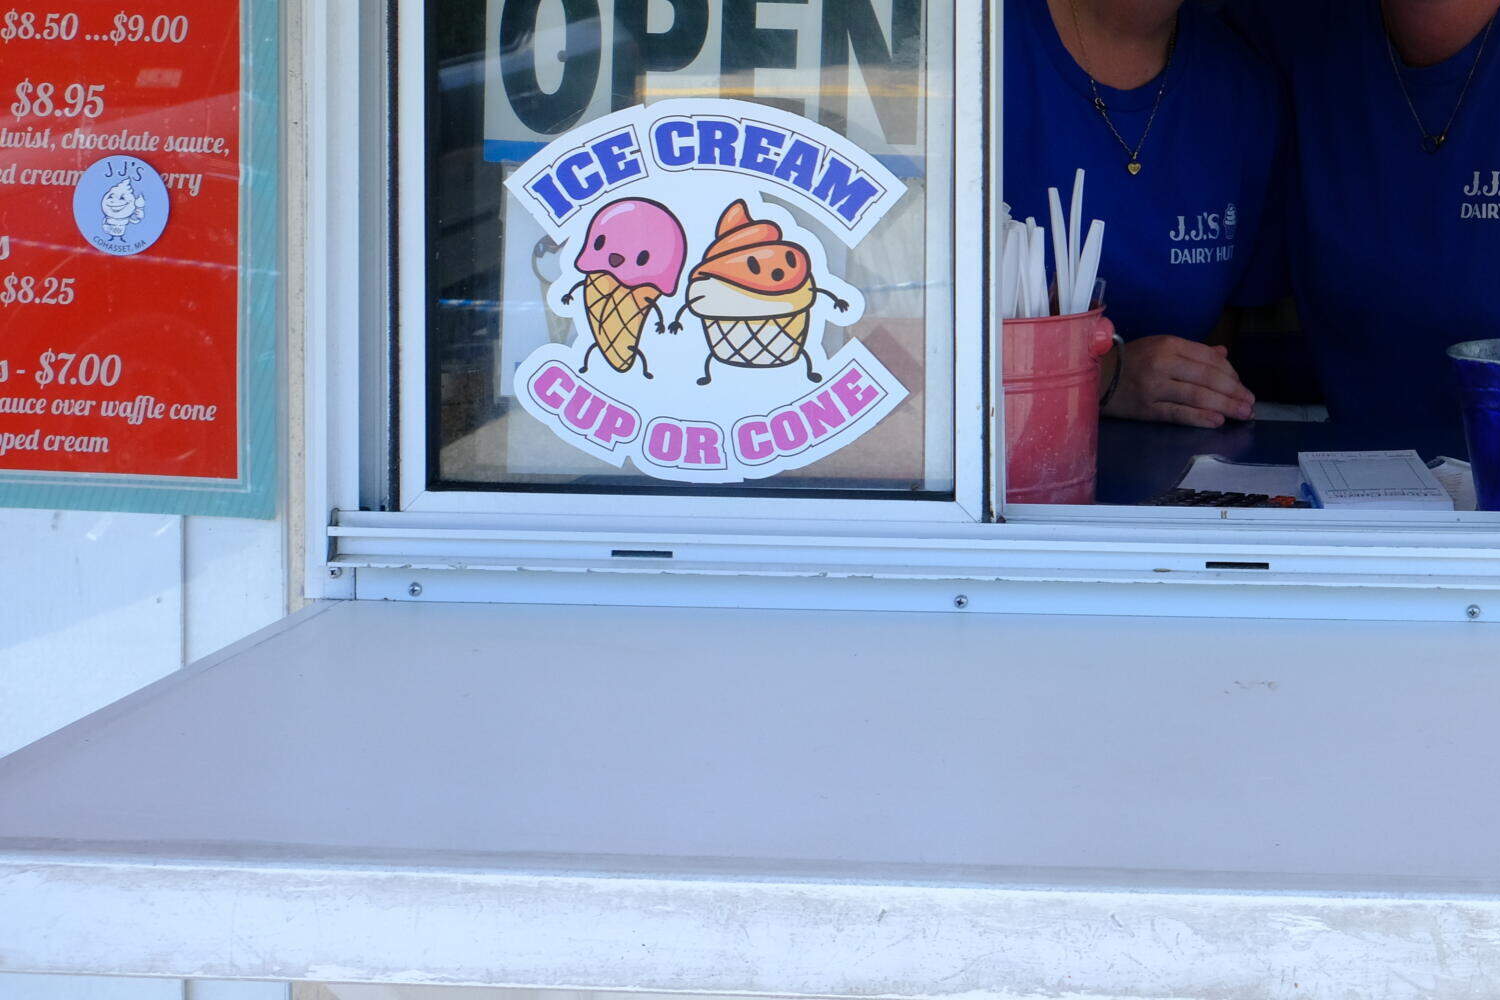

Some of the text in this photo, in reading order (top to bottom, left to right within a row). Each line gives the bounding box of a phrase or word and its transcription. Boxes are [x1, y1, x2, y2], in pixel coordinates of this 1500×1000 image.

[11, 79, 105, 119] $8.95
[61, 131, 230, 156] chocolate sauce,
[531, 120, 878, 224] ICE CREAM
[1170, 212, 1220, 241] J.J.'S
[1171, 247, 1215, 264] DAIRY
[532, 366, 880, 464] CUP OR CONE
